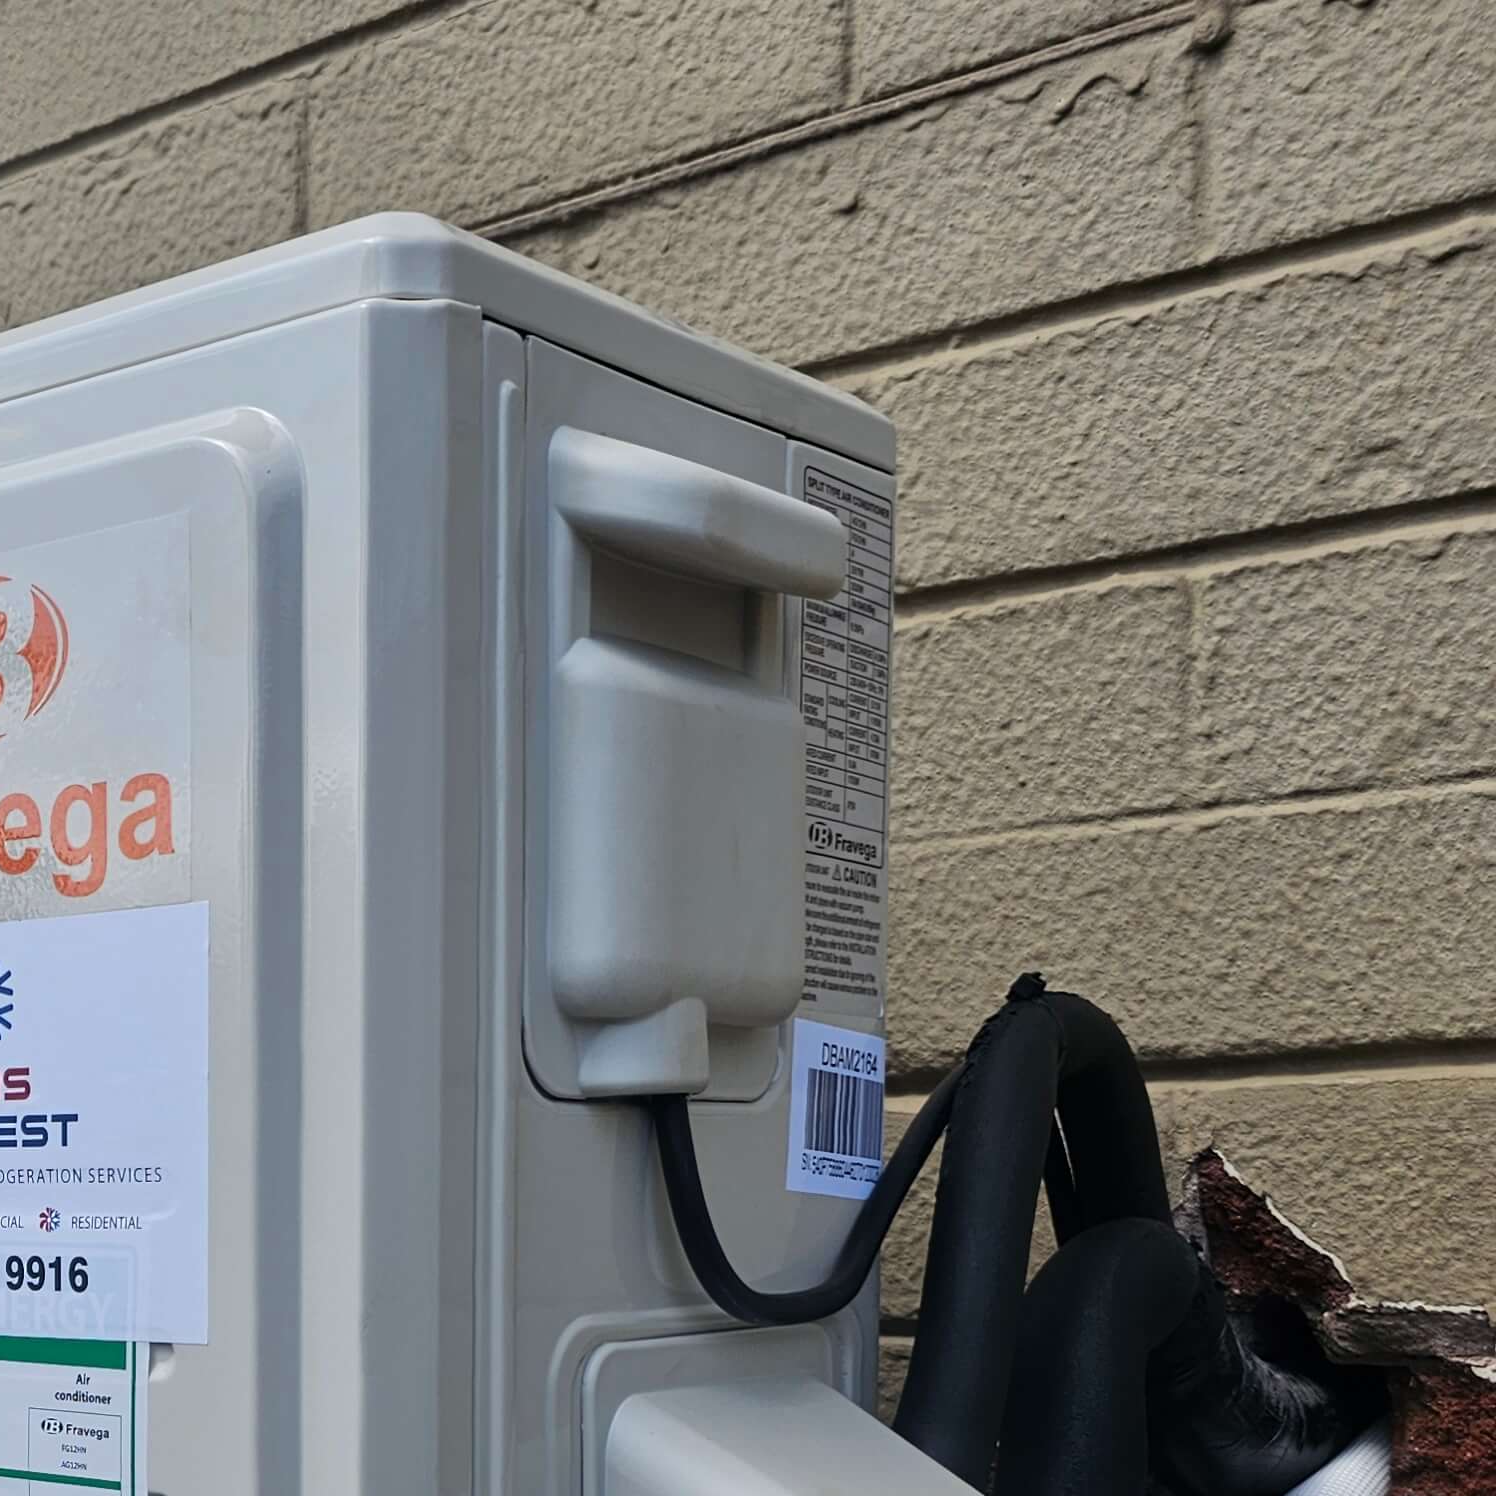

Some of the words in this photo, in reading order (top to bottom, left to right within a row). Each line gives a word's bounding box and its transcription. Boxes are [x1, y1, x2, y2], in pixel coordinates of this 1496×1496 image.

[835, 832, 877, 861] Fravega
[844, 867, 878, 889] CAUTION
[821, 1042, 878, 1075] DBAM2164
[88, 1167, 163, 1184] SERVICES
[71, 1216, 143, 1230] RESIDENTIAL
[5, 1255, 89, 1293] 9916
[75, 1373, 91, 1385] Air
[54, 1390, 112, 1405] conditioner
[66, 1423, 110, 1440] Fravega
